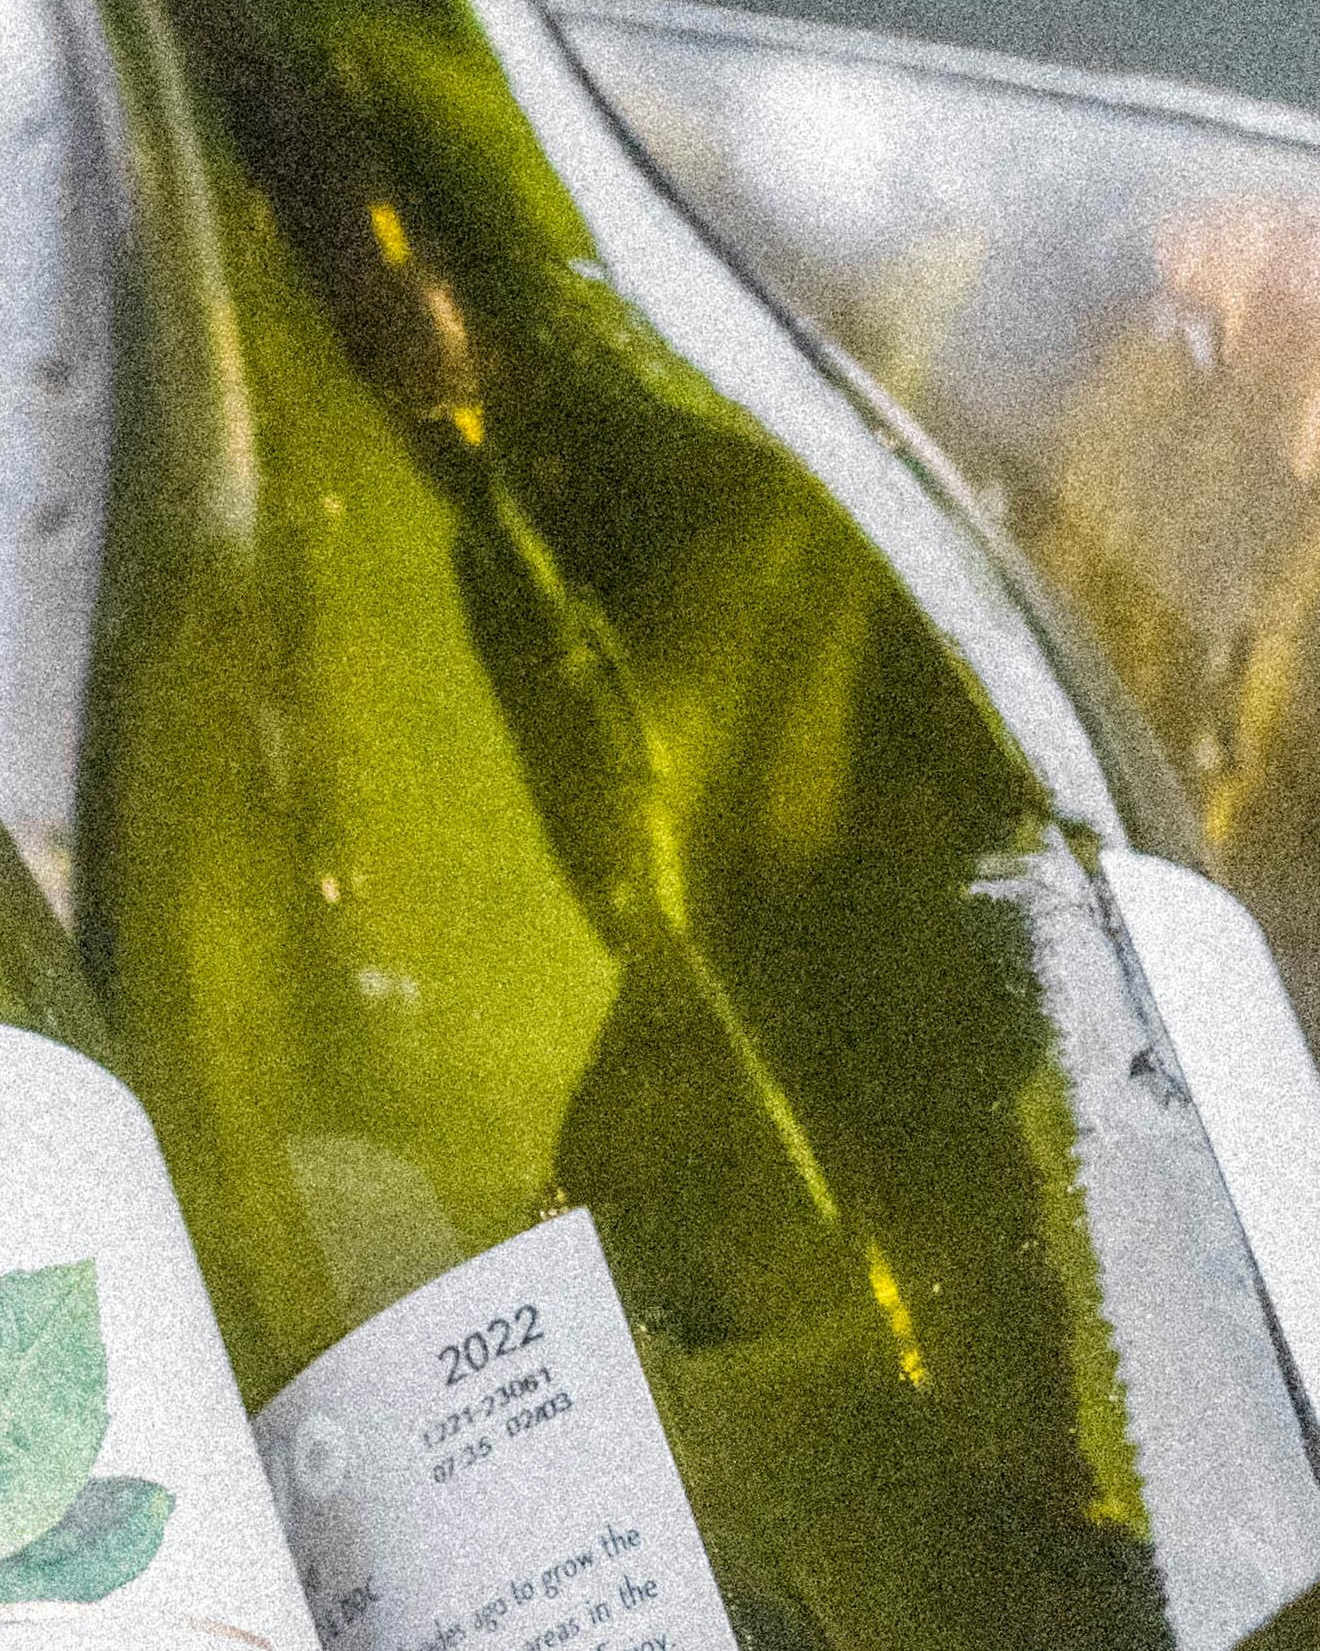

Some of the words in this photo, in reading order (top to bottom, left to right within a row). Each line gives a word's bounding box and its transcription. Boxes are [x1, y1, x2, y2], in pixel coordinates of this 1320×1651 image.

[437, 1304, 544, 1386] 2022
[473, 1598, 508, 1633] ago
[510, 1580, 535, 1607] to
[540, 1553, 594, 1599] grow
[600, 1524, 641, 1560] the
[587, 1598, 611, 1626] in
[618, 1574, 658, 1612] the
